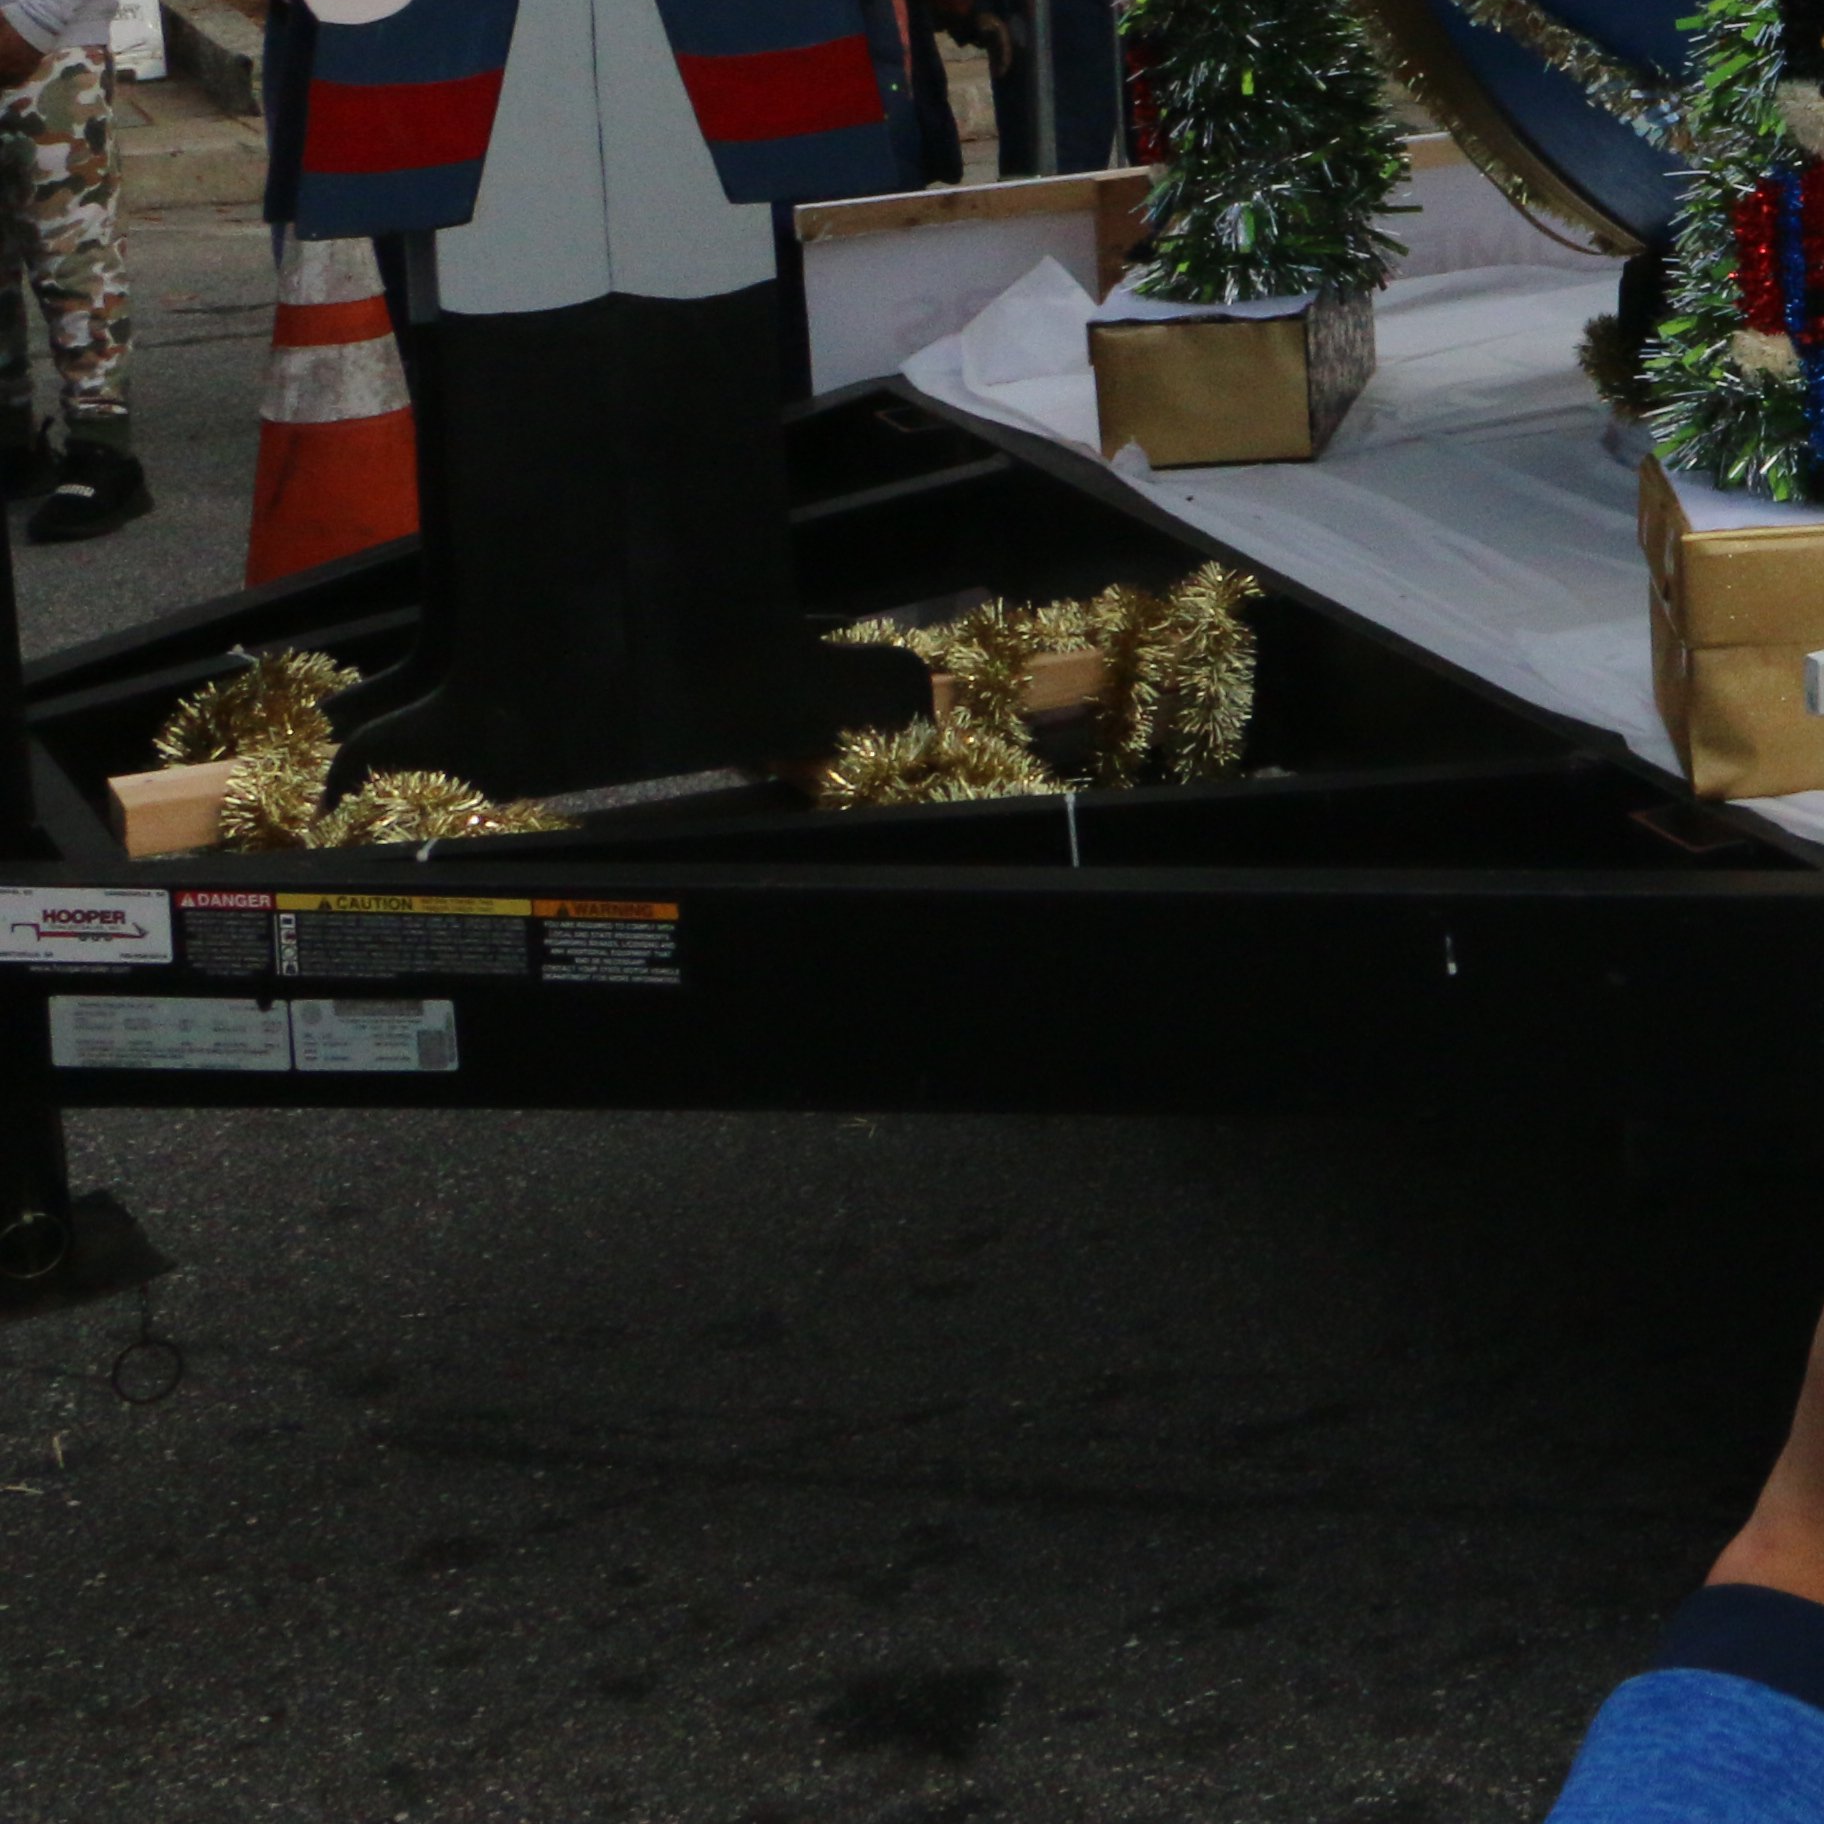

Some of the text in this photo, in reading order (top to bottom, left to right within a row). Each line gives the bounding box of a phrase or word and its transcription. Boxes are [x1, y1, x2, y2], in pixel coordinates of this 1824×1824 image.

[197, 893, 272, 908] DANGER
[336, 896, 414, 911] CAUTION
[573, 902, 655, 918] WARNING
[42, 909, 126, 925] HOOPER
